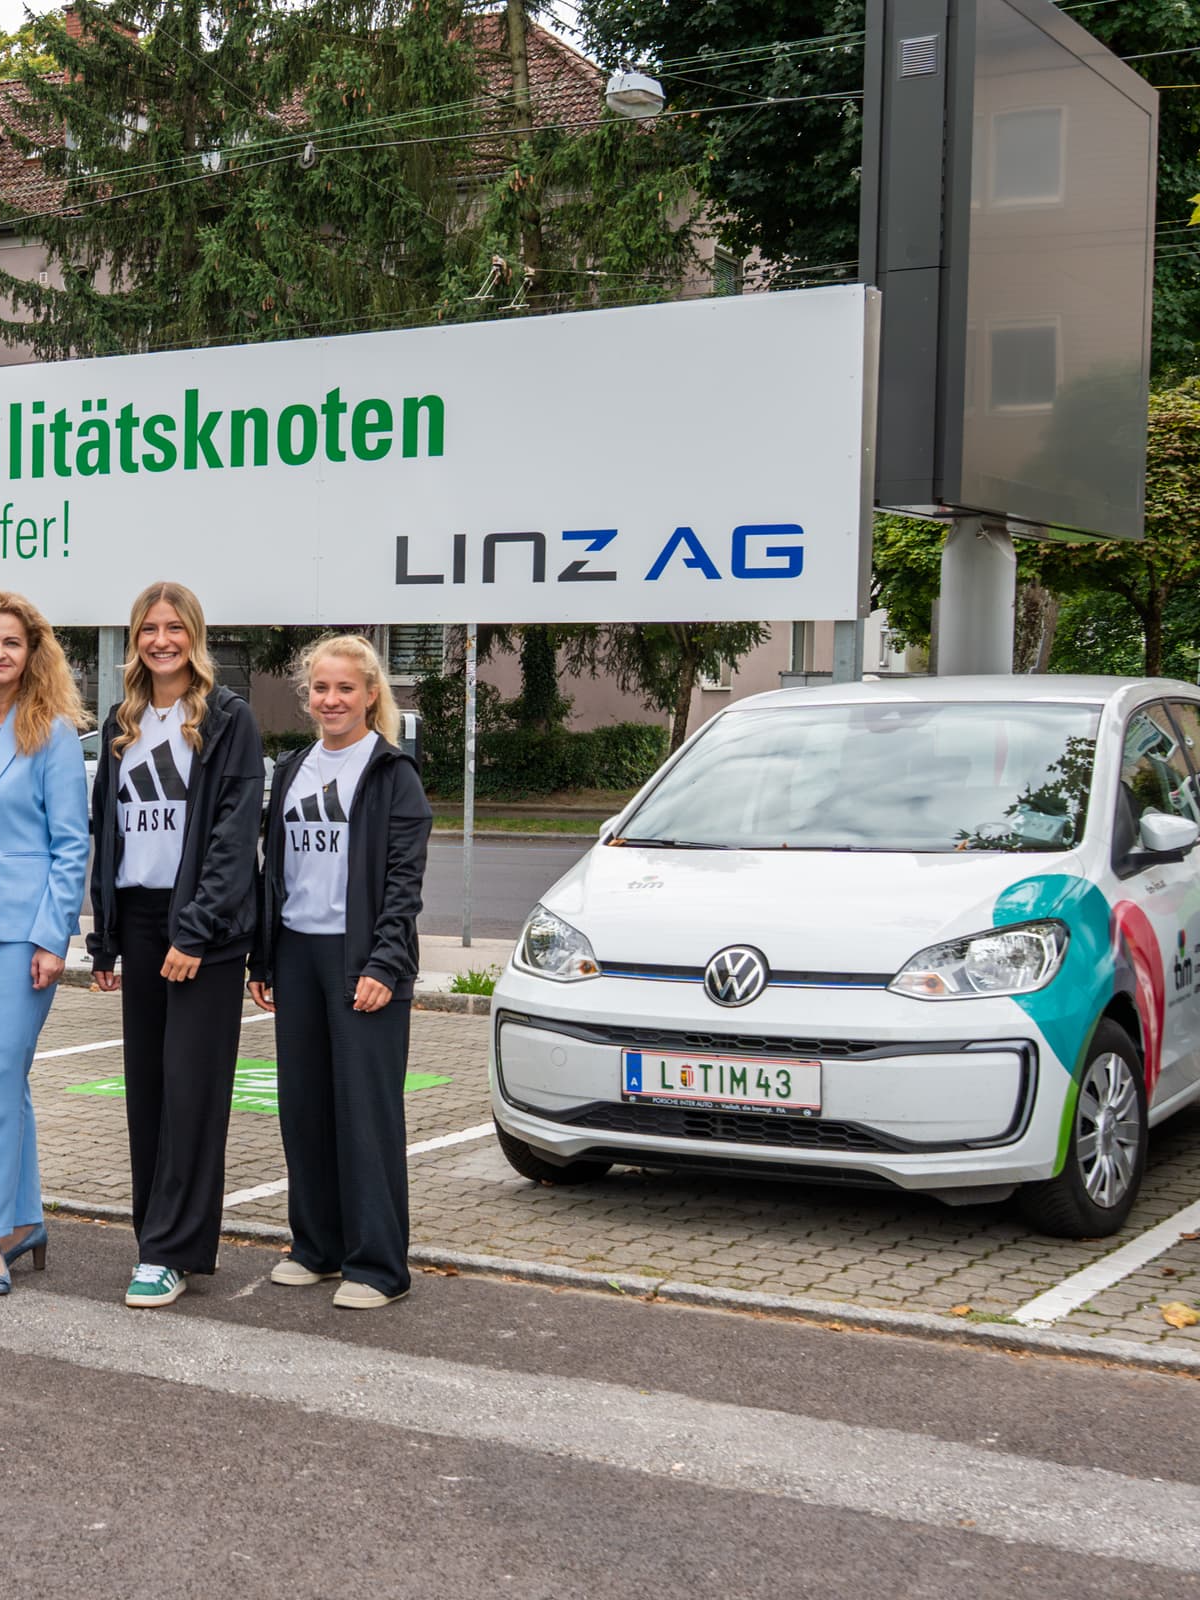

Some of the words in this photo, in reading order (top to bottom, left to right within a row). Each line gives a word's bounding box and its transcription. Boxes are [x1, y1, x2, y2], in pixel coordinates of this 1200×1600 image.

[644, 523, 805, 581] AG
[125, 808, 176, 833] LASK
[290, 829, 340, 853] LASK
[629, 1077, 639, 1087] A
[661, 1061, 674, 1090] L
